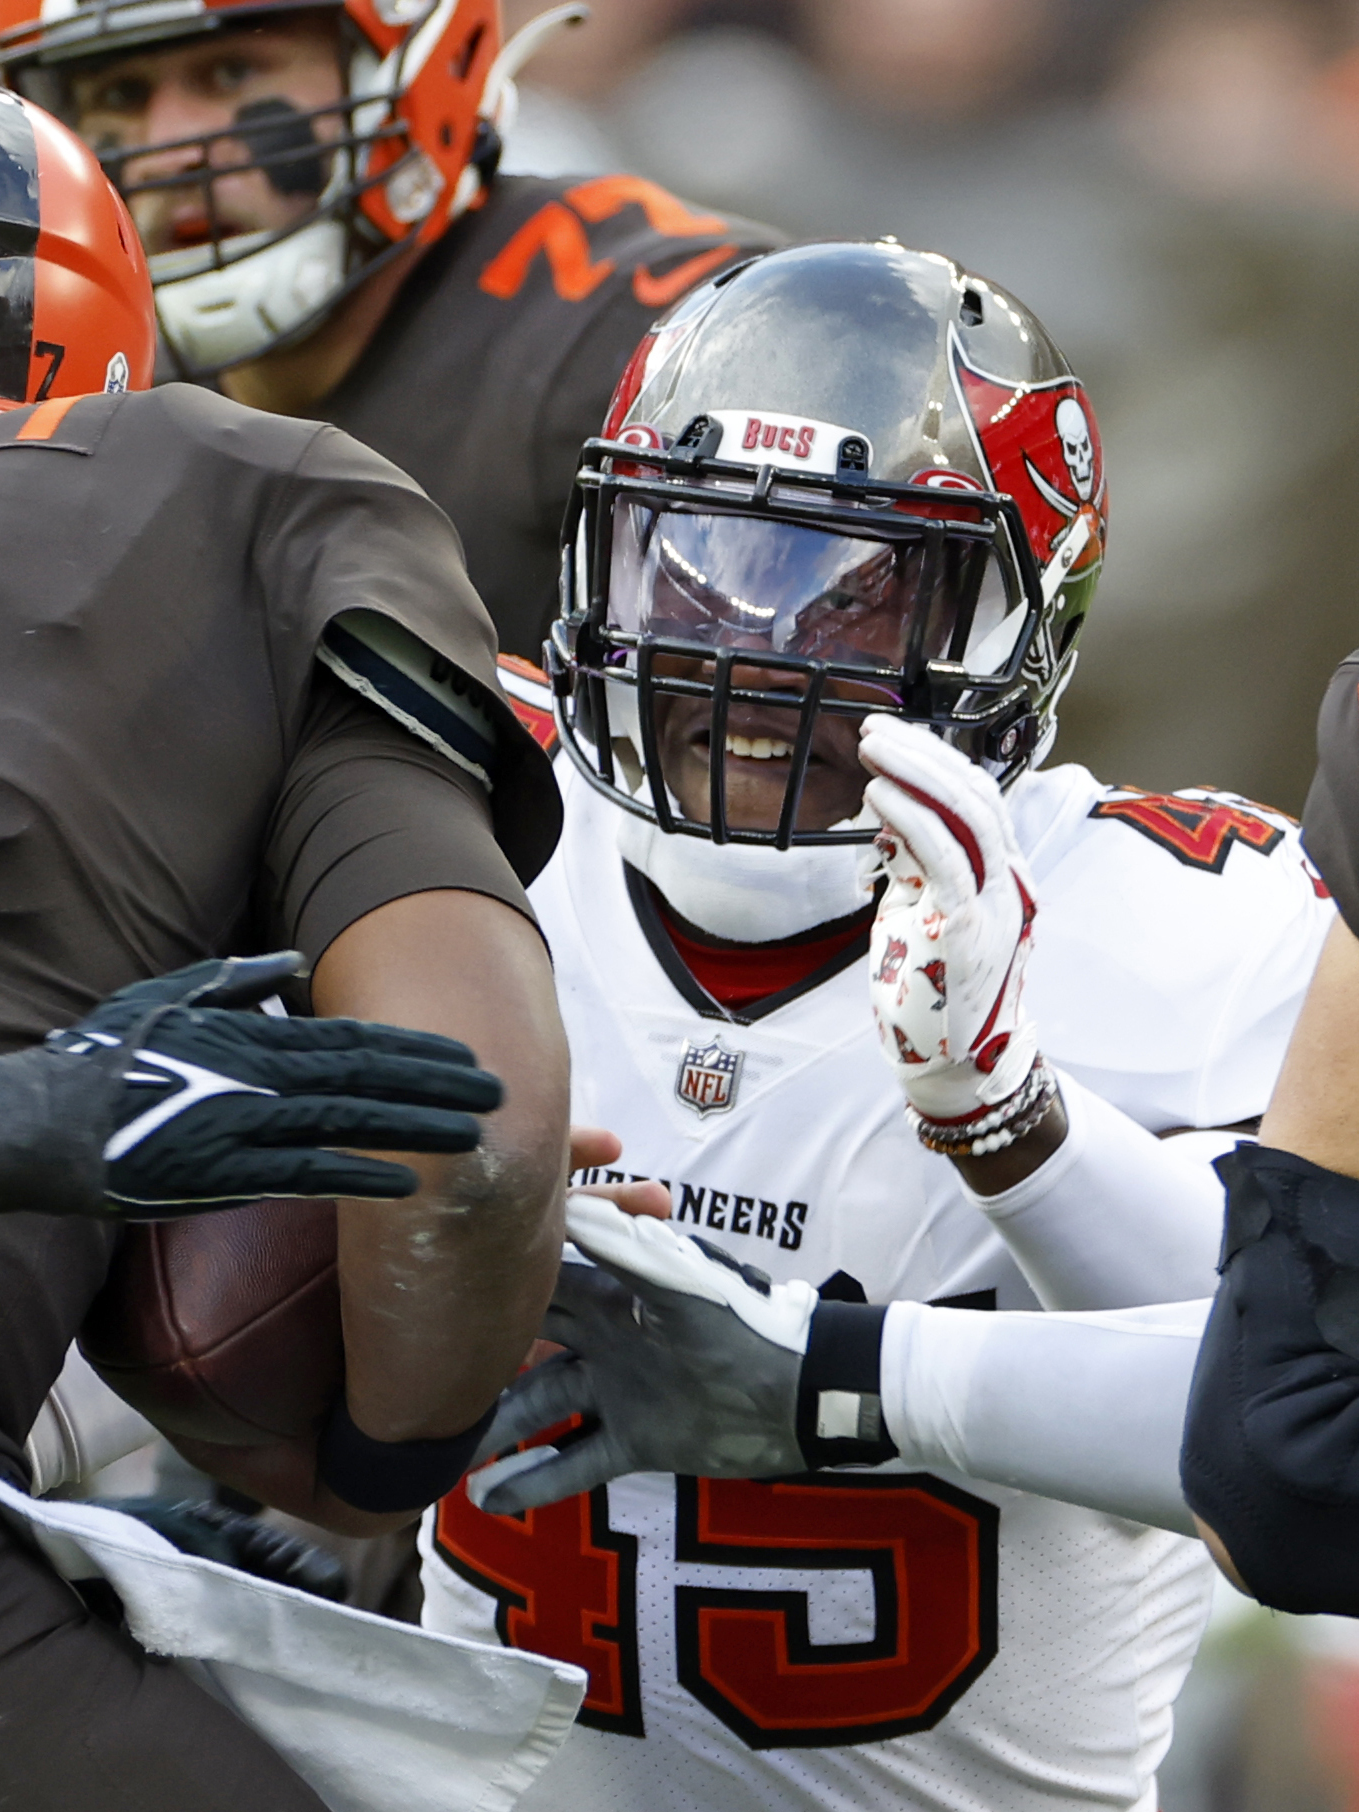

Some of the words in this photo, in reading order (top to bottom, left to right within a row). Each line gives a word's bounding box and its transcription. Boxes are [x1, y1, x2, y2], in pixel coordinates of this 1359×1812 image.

[34, 340, 66, 403] 7
[683, 1068, 727, 1104] NFL
[432, 1269, 1000, 1750] 45
